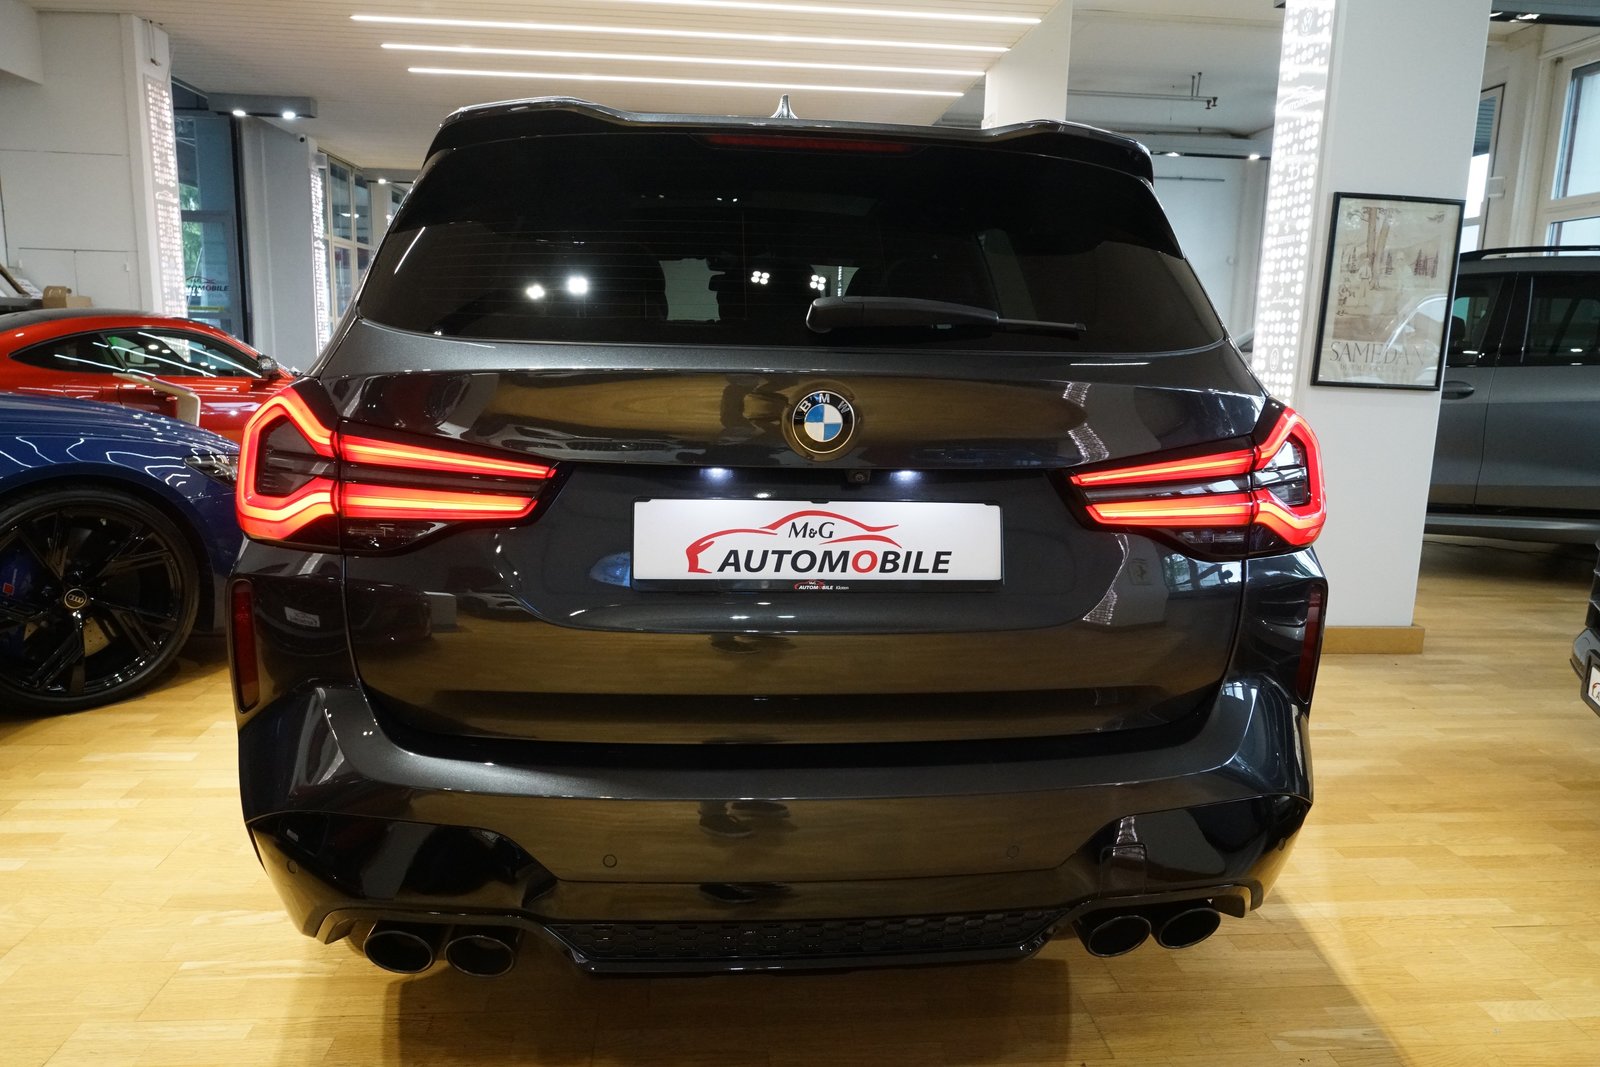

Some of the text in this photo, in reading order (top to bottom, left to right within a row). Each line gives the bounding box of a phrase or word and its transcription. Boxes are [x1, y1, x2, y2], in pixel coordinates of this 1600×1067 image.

[799, 393, 850, 414] BMW
[788, 521, 834, 539] M&G
[717, 549, 952, 574] AUTOMOBILE
